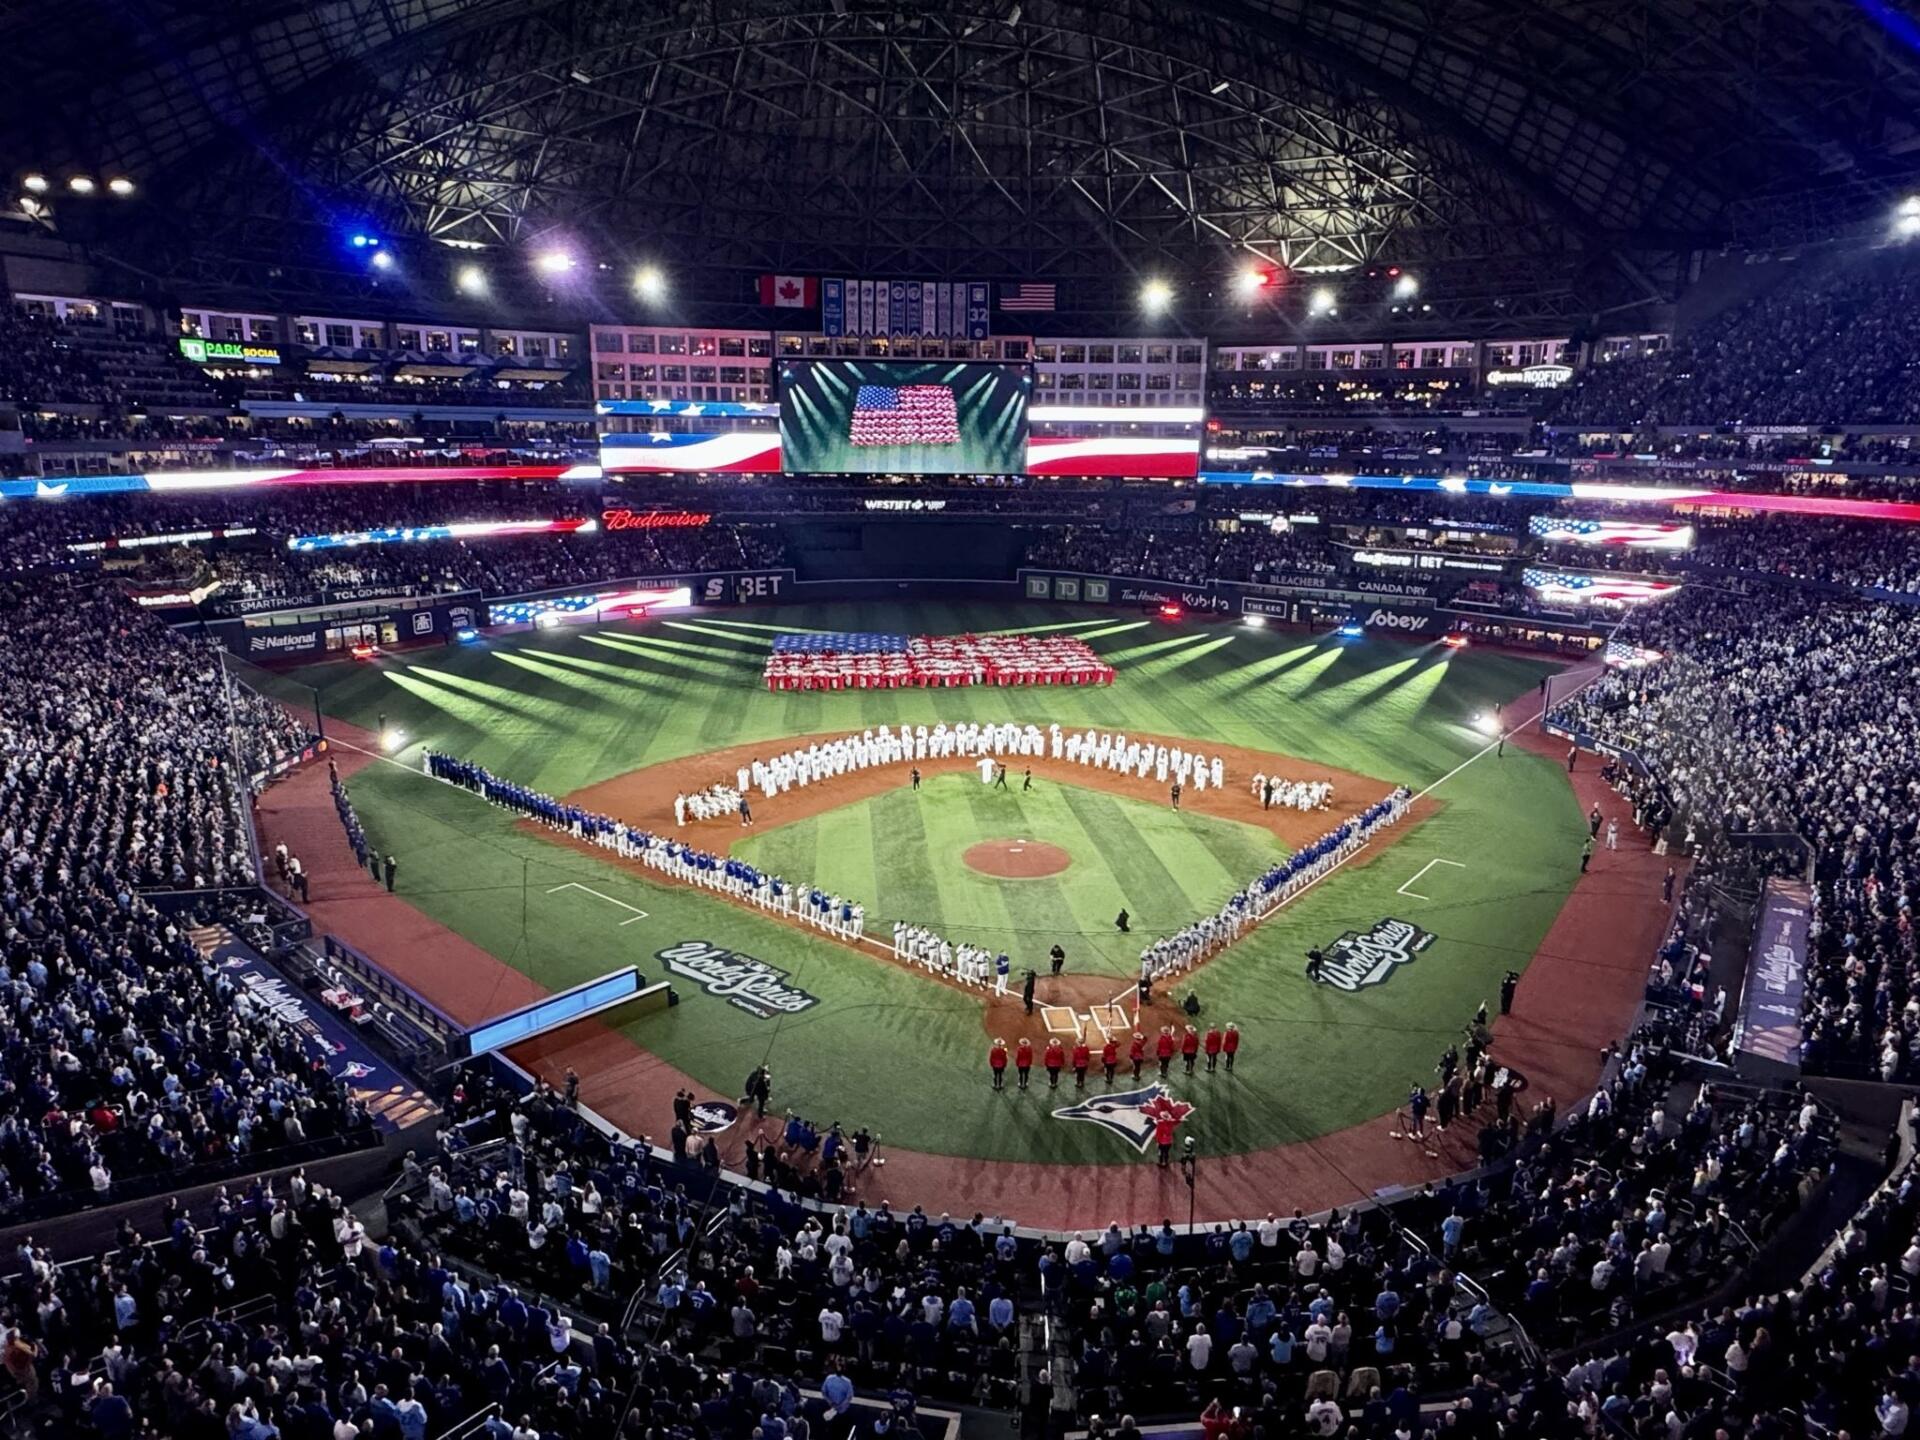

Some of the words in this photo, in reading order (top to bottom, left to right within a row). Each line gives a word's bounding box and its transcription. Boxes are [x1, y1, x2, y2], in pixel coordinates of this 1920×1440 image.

[970, 308, 988, 322] 32
[206, 343, 242, 356] PARK
[243, 348, 278, 357] SOCIAL
[1523, 370, 1572, 383] ROOFTOP
[864, 500, 912, 510] WESTJET
[602, 510, 711, 530] Budweiser
[1420, 556, 1444, 569] BET
[740, 576, 782, 596] BET
[1030, 580, 1048, 594] TD
[1270, 575, 1326, 588] BLEACHERS
[334, 591, 357, 600] TCL
[1088, 583, 1106, 598] TD
[1358, 582, 1403, 594] CANADA
[1406, 586, 1428, 596] DRY
[241, 595, 315, 612] SMARTPHONE
[1247, 603, 1263, 611] THE
[1365, 609, 1428, 631] Sobeys
[266, 632, 316, 648] National
